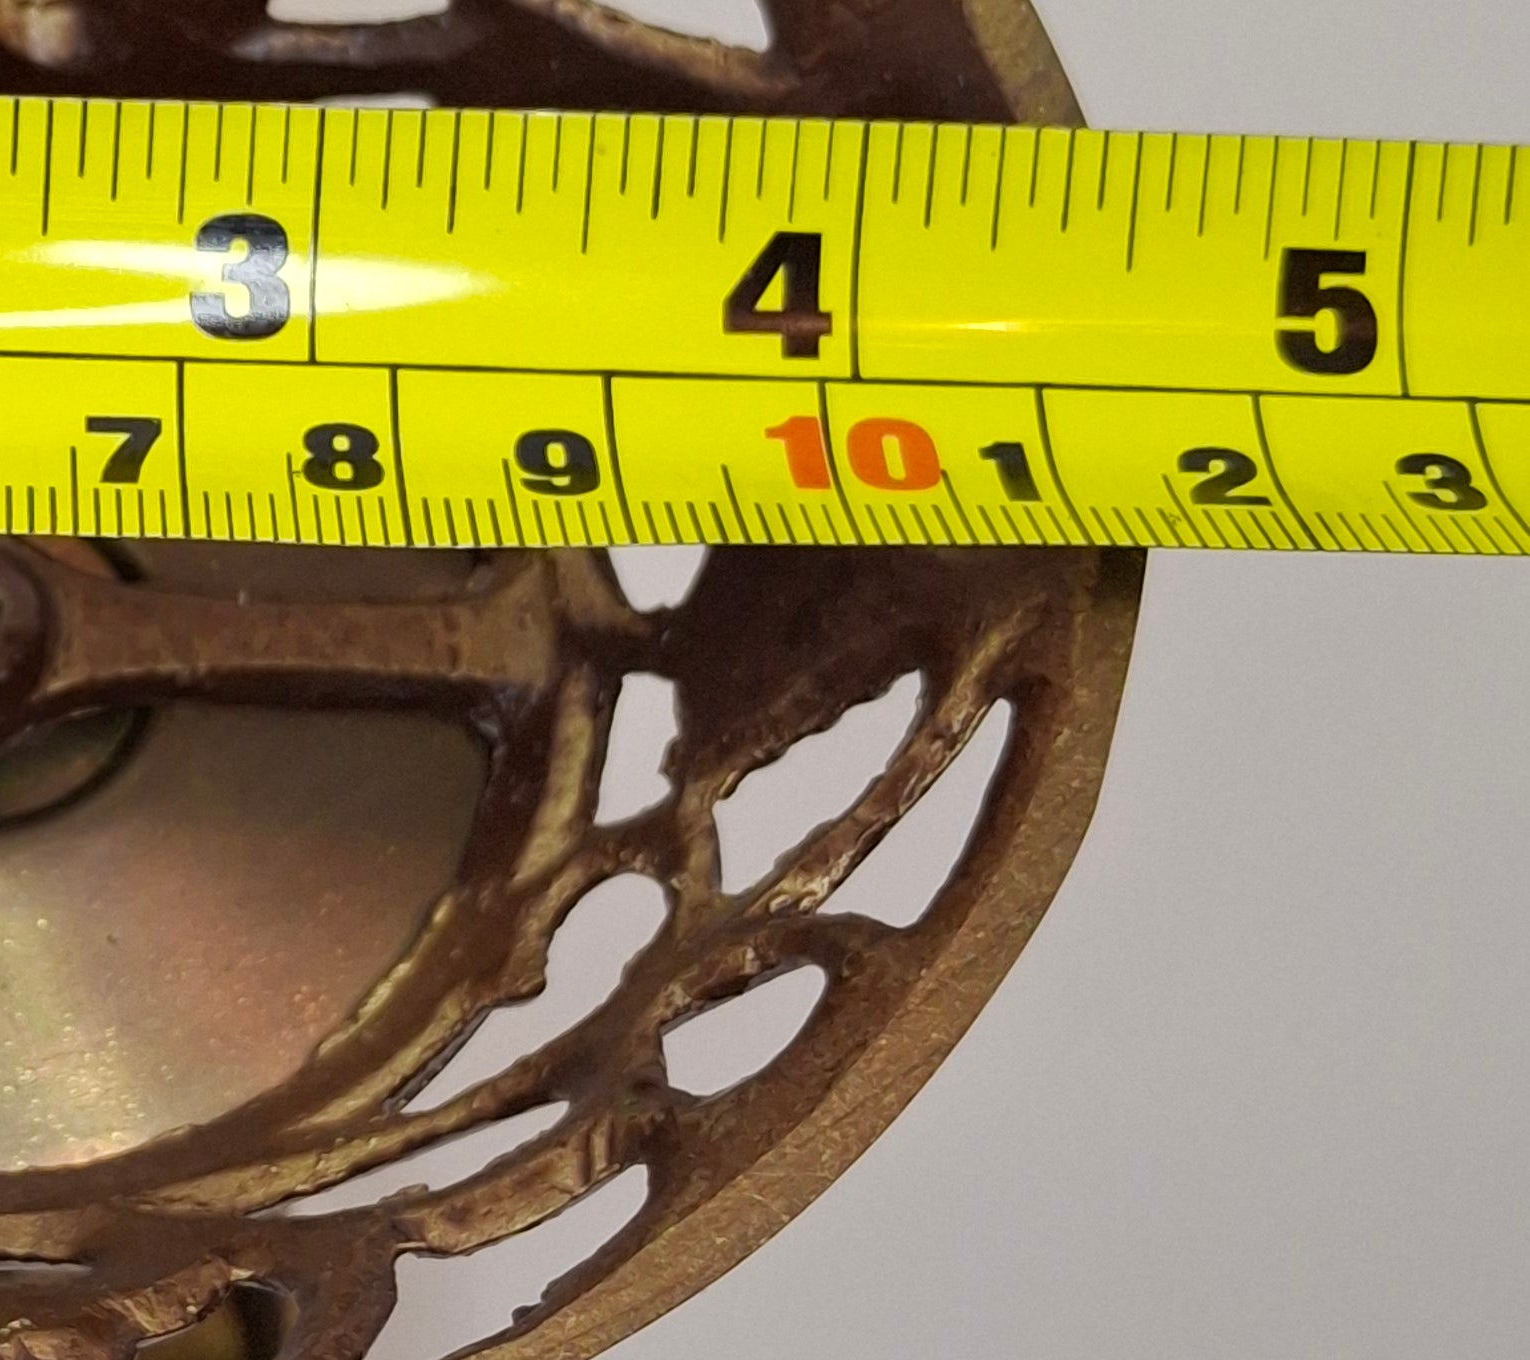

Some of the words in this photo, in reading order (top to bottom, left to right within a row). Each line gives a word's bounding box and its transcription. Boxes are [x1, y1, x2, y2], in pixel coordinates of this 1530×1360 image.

[190, 213, 291, 340] 3
[722, 231, 833, 359] 4
[1273, 247, 1377, 376] 5
[85, 417, 161, 484] 7
[303, 424, 385, 492] 8
[514, 428, 600, 496] 9
[765, 415, 942, 491] 10
[978, 441, 1044, 502] 1
[1178, 448, 1270, 506] 2
[1394, 453, 1487, 512] 3
